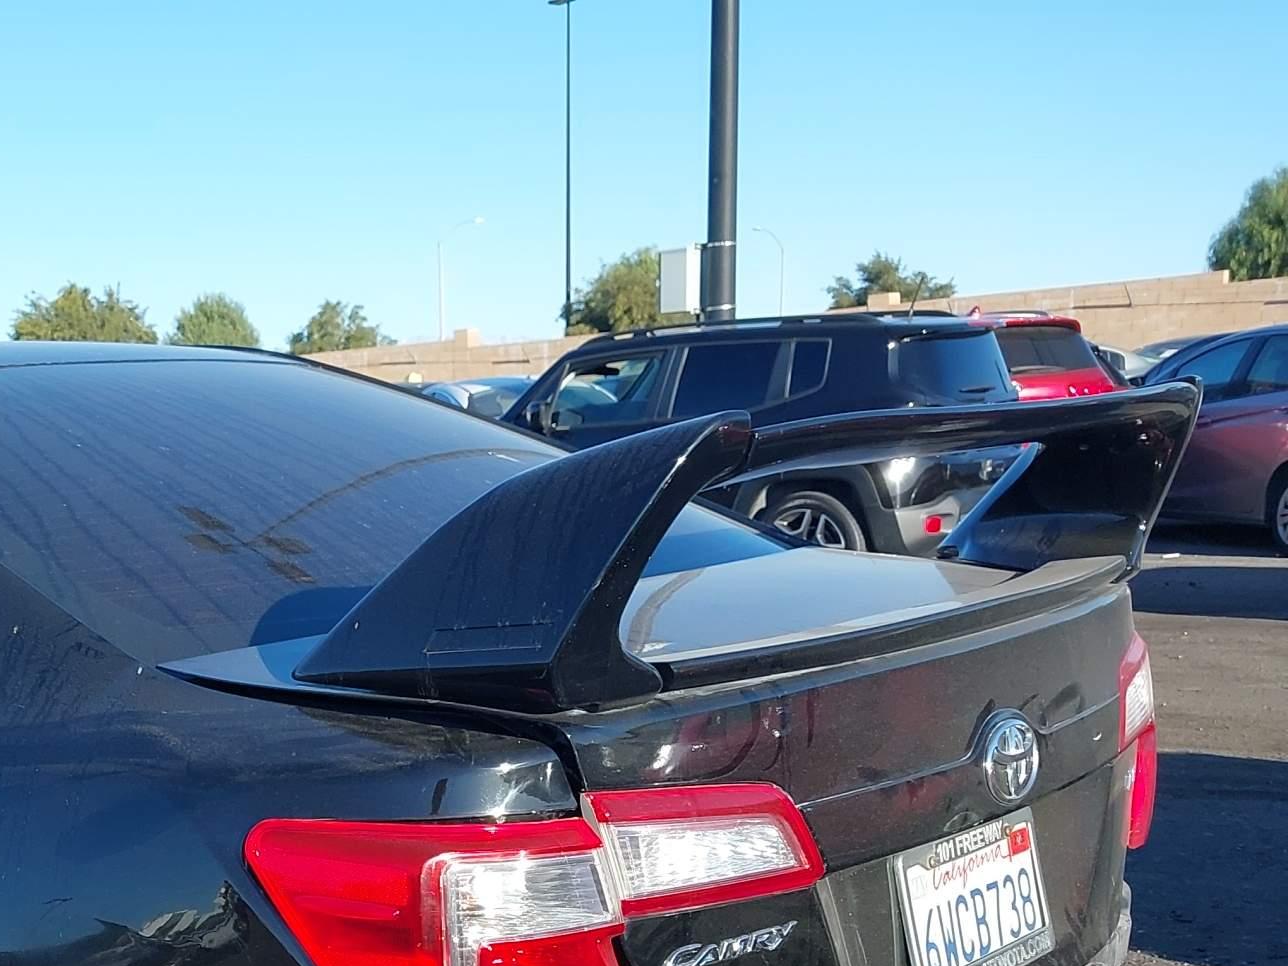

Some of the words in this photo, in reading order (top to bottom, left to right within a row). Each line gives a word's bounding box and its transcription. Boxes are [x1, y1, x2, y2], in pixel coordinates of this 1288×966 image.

[935, 840, 957, 863] 101
[956, 820, 1004, 858] FREEWAY
[932, 843, 1012, 890] California
